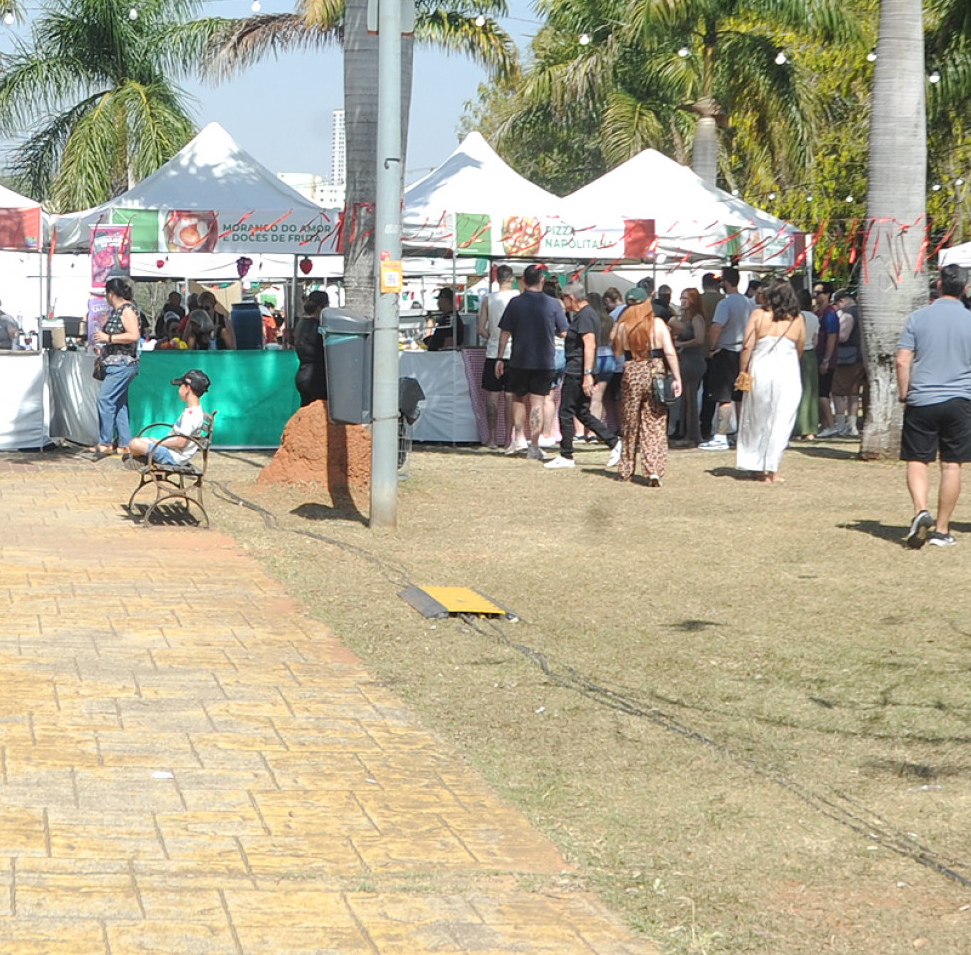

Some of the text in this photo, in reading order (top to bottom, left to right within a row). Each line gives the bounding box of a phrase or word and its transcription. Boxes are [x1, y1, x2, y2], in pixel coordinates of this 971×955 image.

[281, 224, 297, 233] DO
[301, 224, 331, 233] AMOR
[545, 225, 575, 236] PIZZA
[223, 234, 230, 242] E
[232, 234, 268, 242] DOCES
[271, 234, 286, 242] DE
